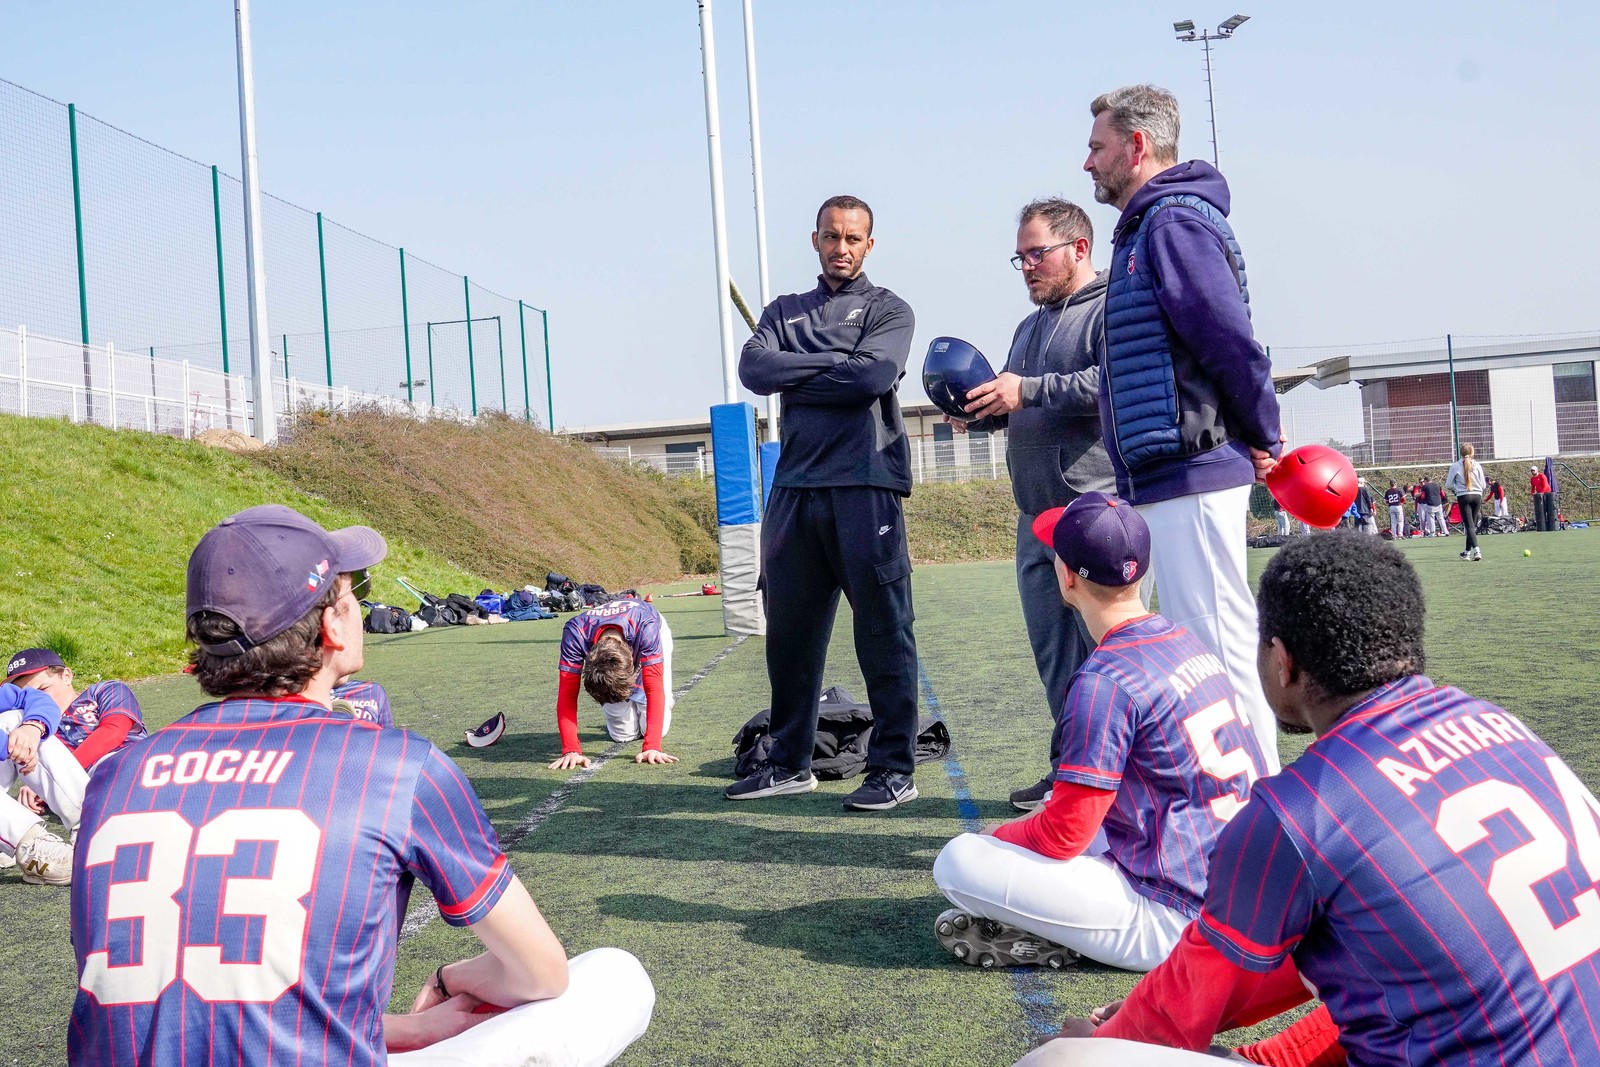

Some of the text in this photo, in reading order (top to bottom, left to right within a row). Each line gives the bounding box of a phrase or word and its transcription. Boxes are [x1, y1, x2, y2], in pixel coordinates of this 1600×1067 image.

[1388, 494, 1399, 503] 22
[141, 750, 295, 788] COCHI
[80, 809, 322, 1005] 33
